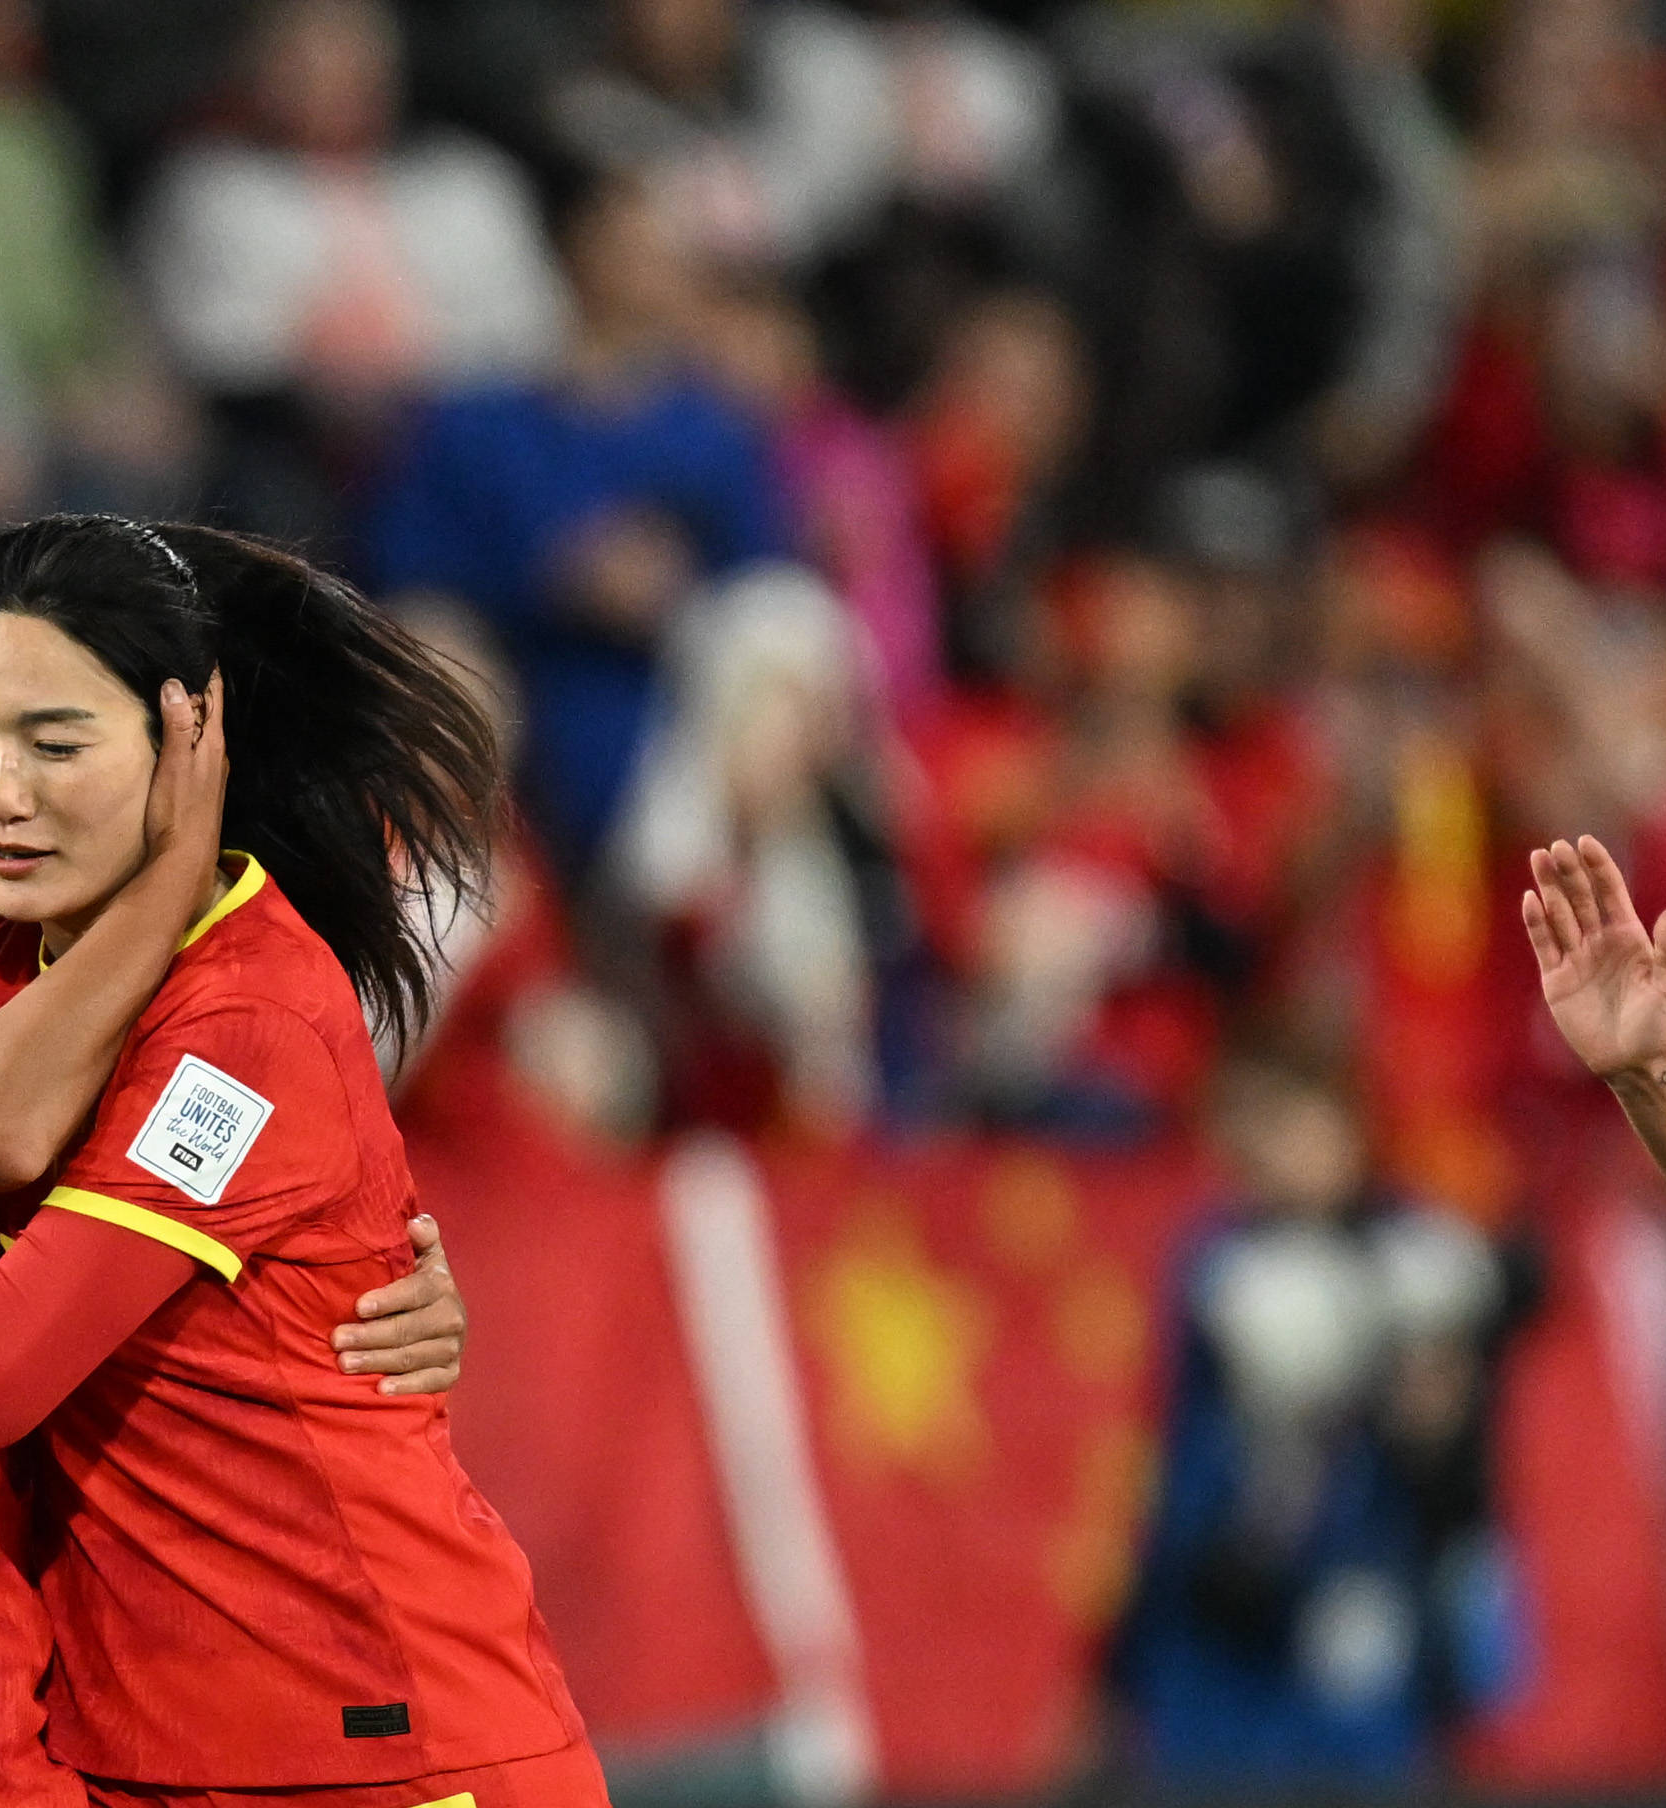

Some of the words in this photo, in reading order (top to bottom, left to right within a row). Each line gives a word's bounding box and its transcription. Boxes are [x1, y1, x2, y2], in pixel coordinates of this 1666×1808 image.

[180, 1097, 236, 1144] UNITES
[190, 1083, 245, 1125] FOOTBALL
[166, 1117, 189, 1138] the
[188, 1129, 229, 1163] World
[172, 1146, 200, 1169] FIFA
